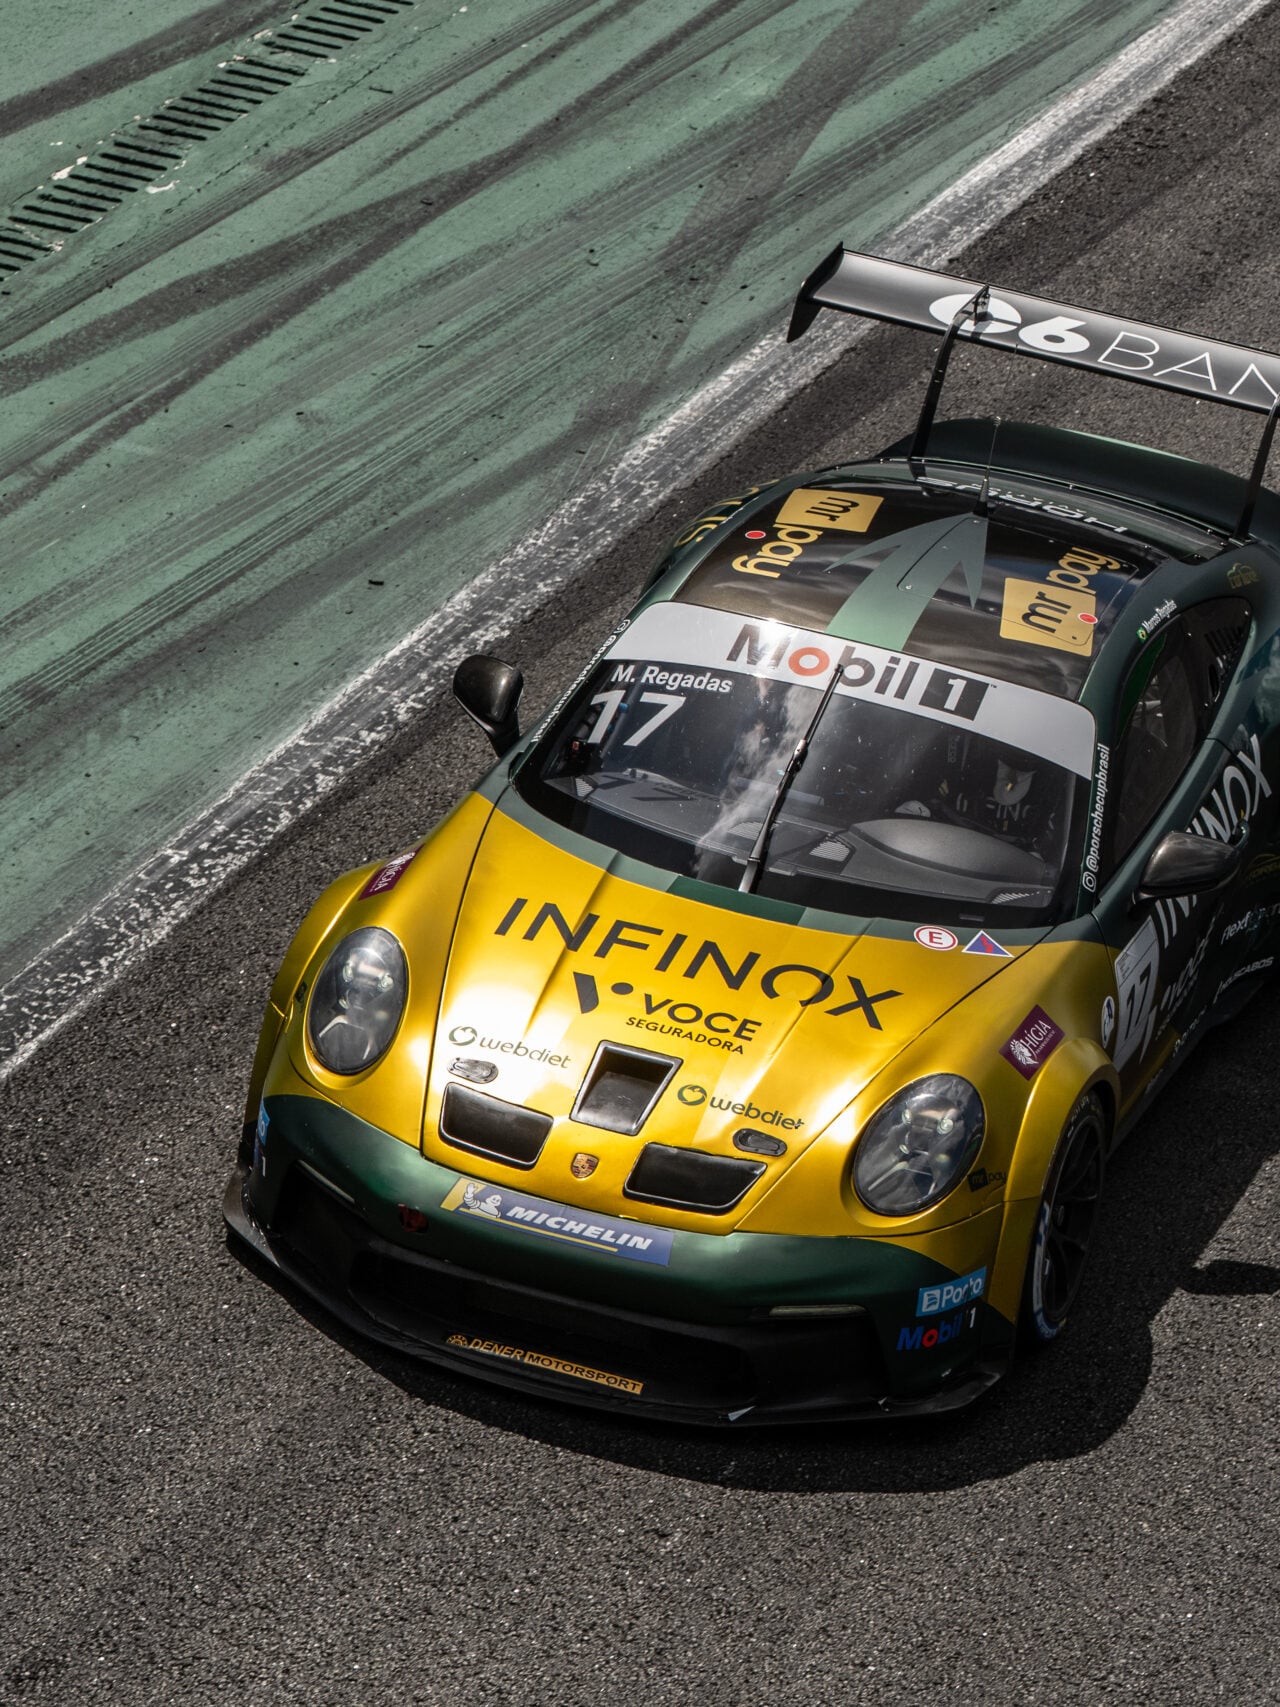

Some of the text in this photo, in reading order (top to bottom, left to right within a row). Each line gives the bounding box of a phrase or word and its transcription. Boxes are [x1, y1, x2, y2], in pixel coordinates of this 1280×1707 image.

[731, 496, 860, 579] mr pay
[1021, 547, 1121, 636] mr pay
[611, 665, 733, 693] M. Regadas
[726, 624, 920, 701] Mobil
[586, 689, 686, 747] 17
[1085, 743, 1110, 872] @porschecupbrasil
[927, 930, 944, 946] E
[494, 898, 903, 1031] INFINOX
[626, 1017, 744, 1055] SEGURADORA
[644, 993, 763, 1042] VOCE
[480, 1036, 571, 1069] webdiet
[710, 1096, 804, 1130] webdiet
[506, 1206, 653, 1250] MICHELIN
[896, 1306, 977, 1351] Mobil 1
[469, 1338, 641, 1392] DENER MOTORSPORT
